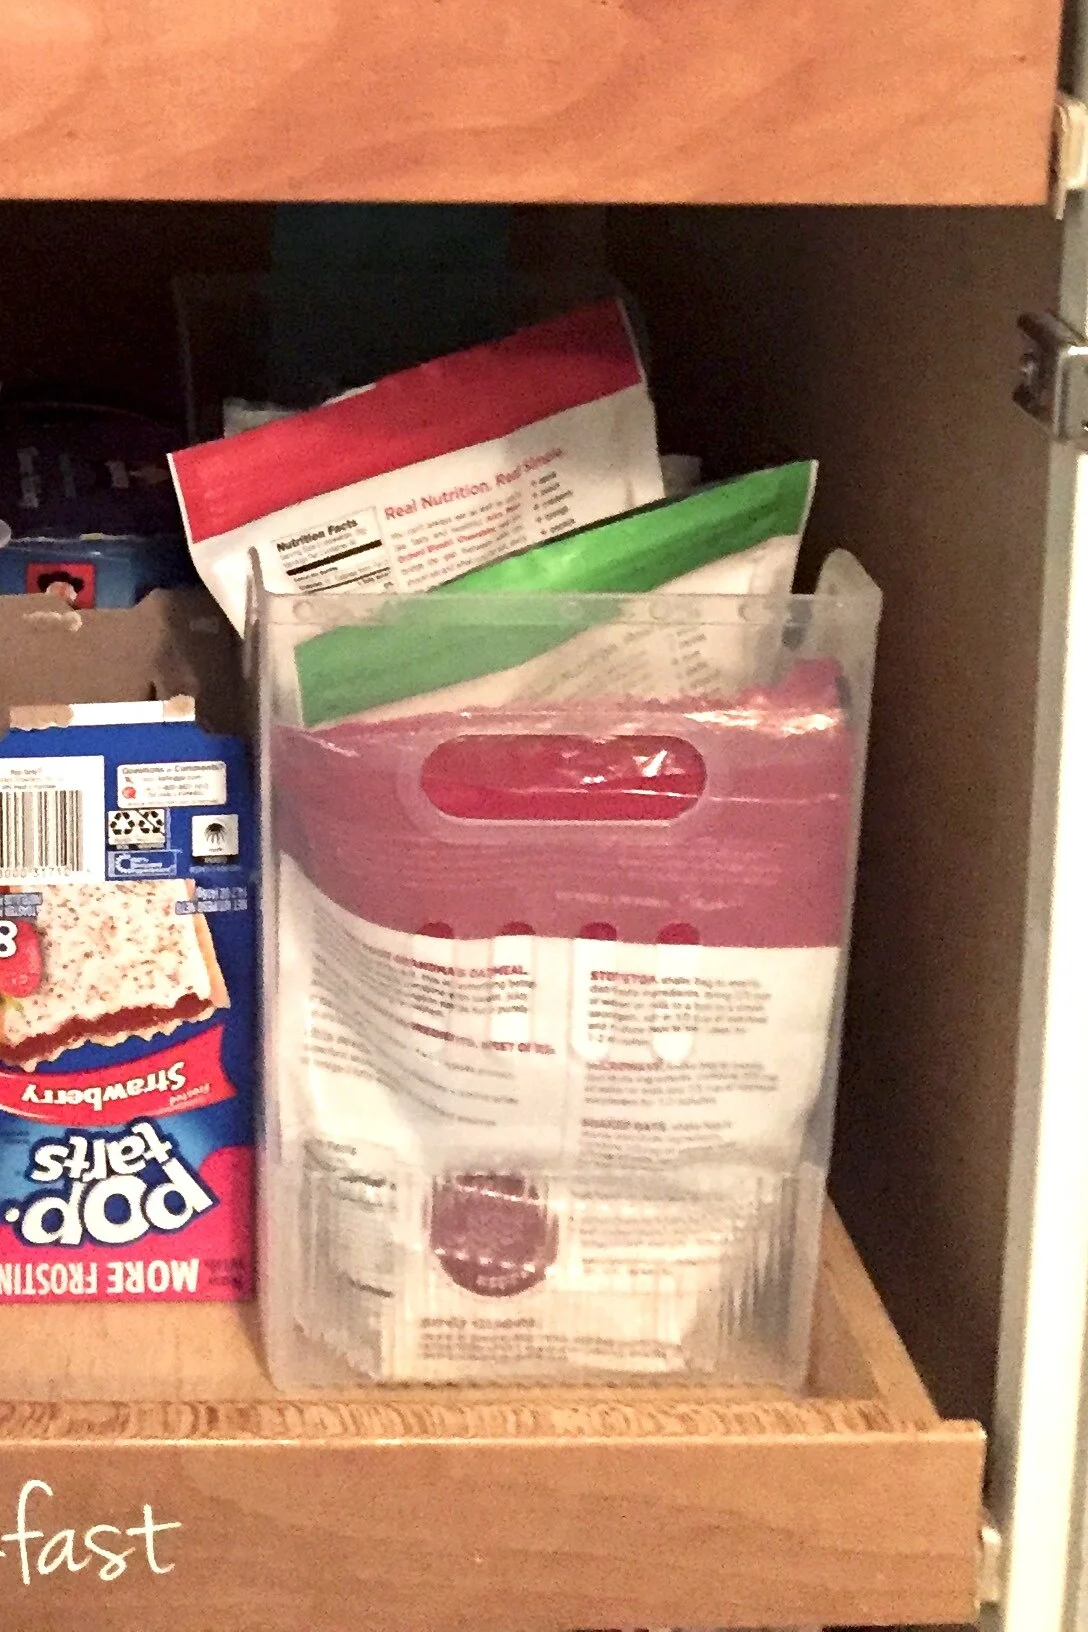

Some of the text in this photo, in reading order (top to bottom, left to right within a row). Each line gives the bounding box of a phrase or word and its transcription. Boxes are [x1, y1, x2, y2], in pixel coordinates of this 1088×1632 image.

[384, 499, 418, 520] Real
[276, 518, 359, 553] Nutrition Facts
[21, 1061, 186, 1109] Strawberry
[34, 1121, 174, 1184] tarts
[103, 1258, 199, 1295] MORE
